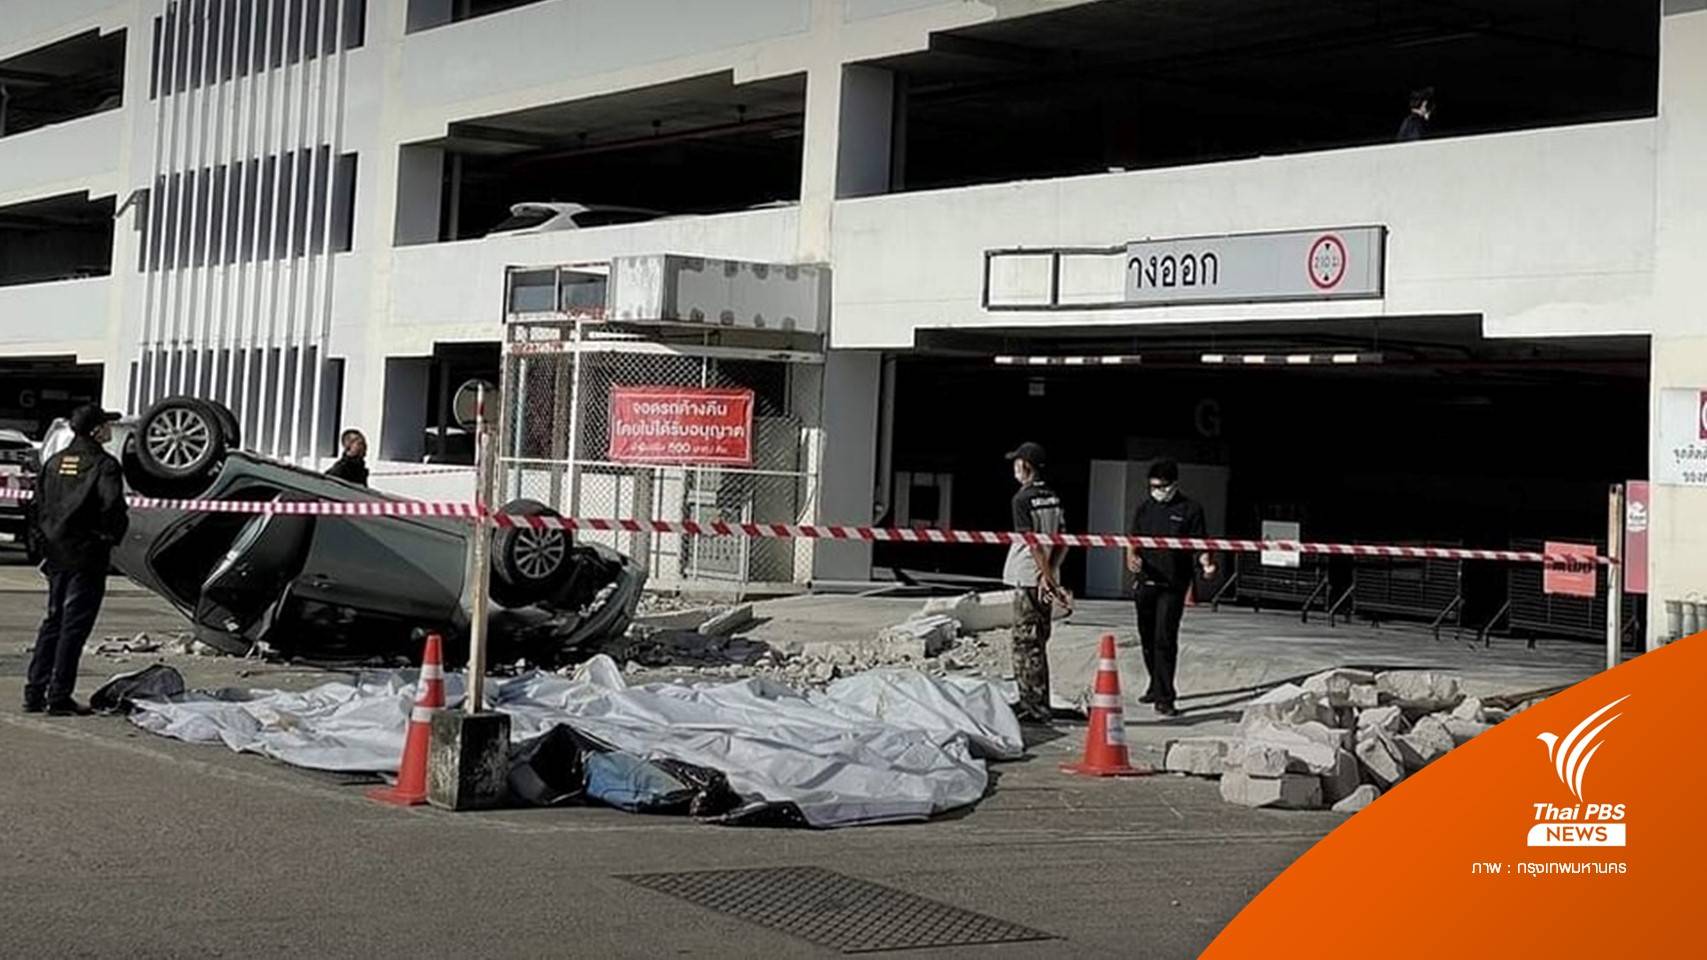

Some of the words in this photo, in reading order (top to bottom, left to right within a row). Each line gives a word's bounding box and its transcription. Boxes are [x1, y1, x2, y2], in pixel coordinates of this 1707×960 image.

[633, 400, 728, 416] จอดรถค้างคืน
[1193, 397, 1223, 439] G
